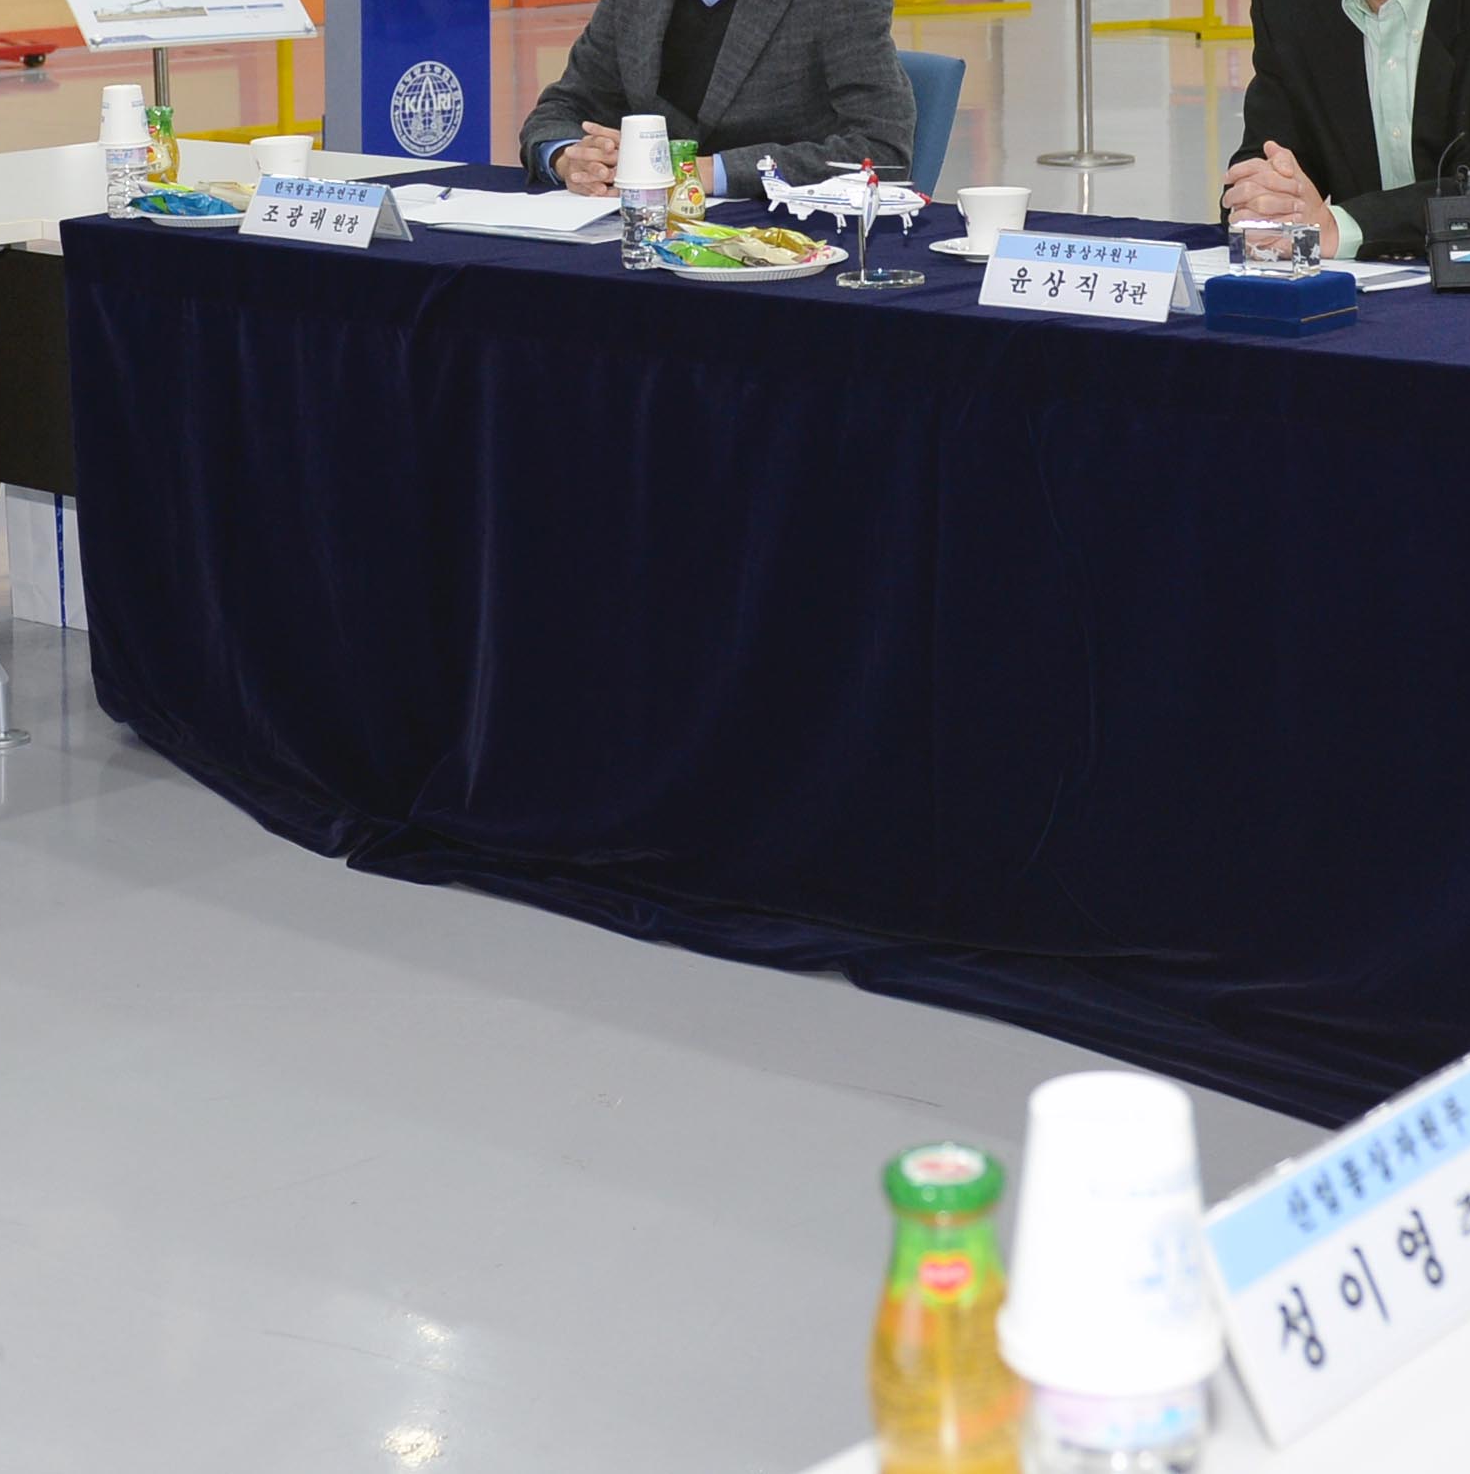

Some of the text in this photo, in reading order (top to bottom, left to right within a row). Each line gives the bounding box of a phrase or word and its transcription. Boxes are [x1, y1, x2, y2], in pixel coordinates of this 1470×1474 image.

[275, 181, 368, 202] 한국항공우주연구원
[332, 213, 359, 234] 원장
[1034, 241, 1138, 265] 산업통상자원부
[1109, 280, 1147, 305] 장관
[1279, 1209, 1444, 1368] 성이영
